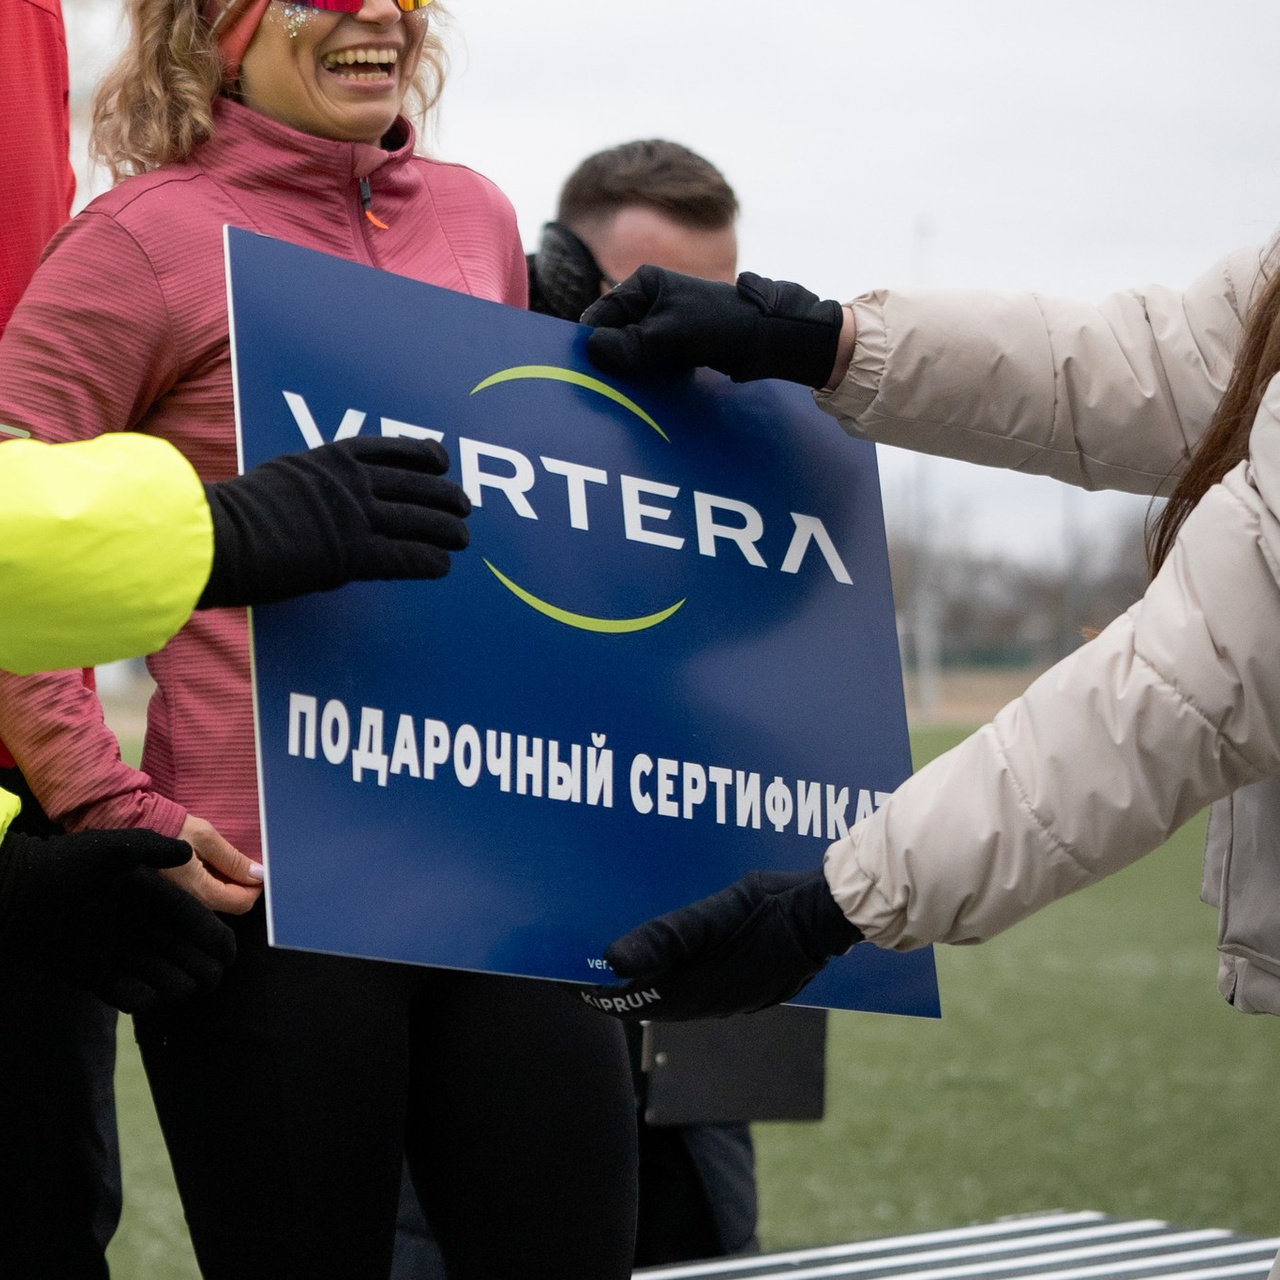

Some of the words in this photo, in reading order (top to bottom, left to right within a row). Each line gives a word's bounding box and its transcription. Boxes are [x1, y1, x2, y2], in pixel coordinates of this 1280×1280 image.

[288, 692, 613, 808] ПОДАРОЧНЫЙ
[587, 958, 614, 971] ver
[581, 987, 661, 1012] KIPRUN
